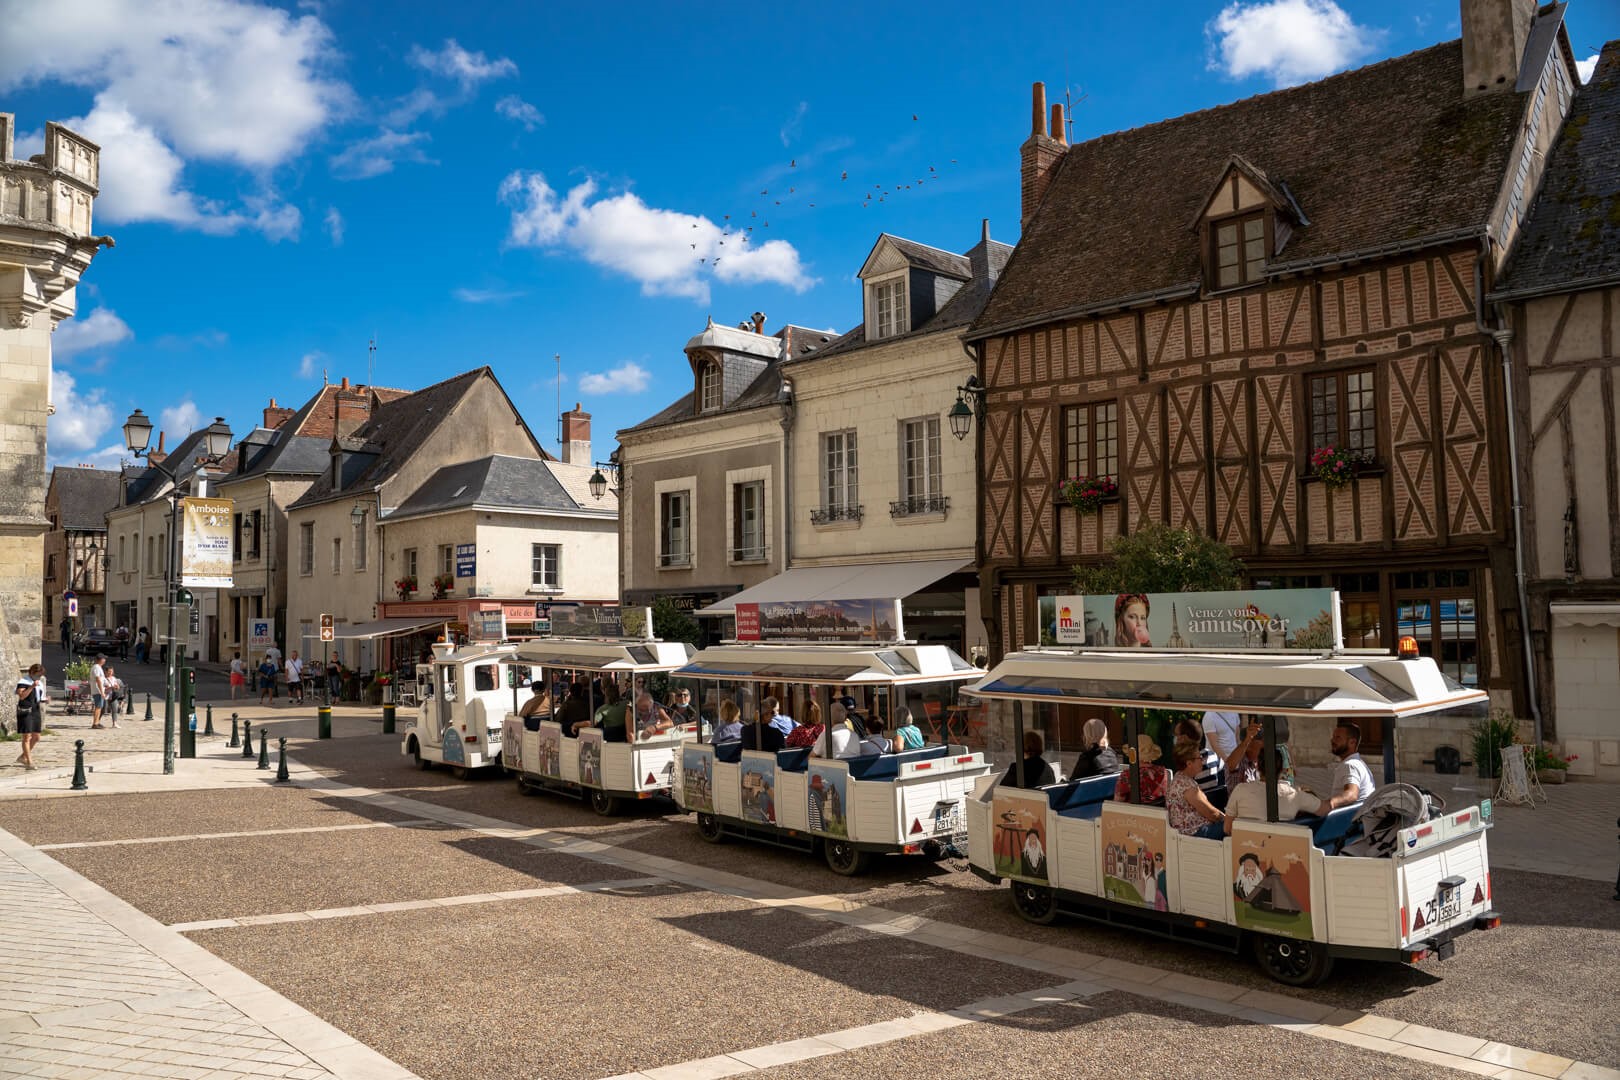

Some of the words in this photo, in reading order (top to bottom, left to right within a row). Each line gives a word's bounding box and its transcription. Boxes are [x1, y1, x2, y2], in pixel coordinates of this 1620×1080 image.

[190, 504, 230, 514] Amboise
[509, 607, 522, 617] Café
[523, 607, 533, 617] des
[592, 607, 622, 627] Villandry
[1187, 606, 1224, 618] Venez
[1227, 607, 1257, 618] vous
[1060, 617, 1081, 628] mini
[1425, 899, 1437, 926] 25
